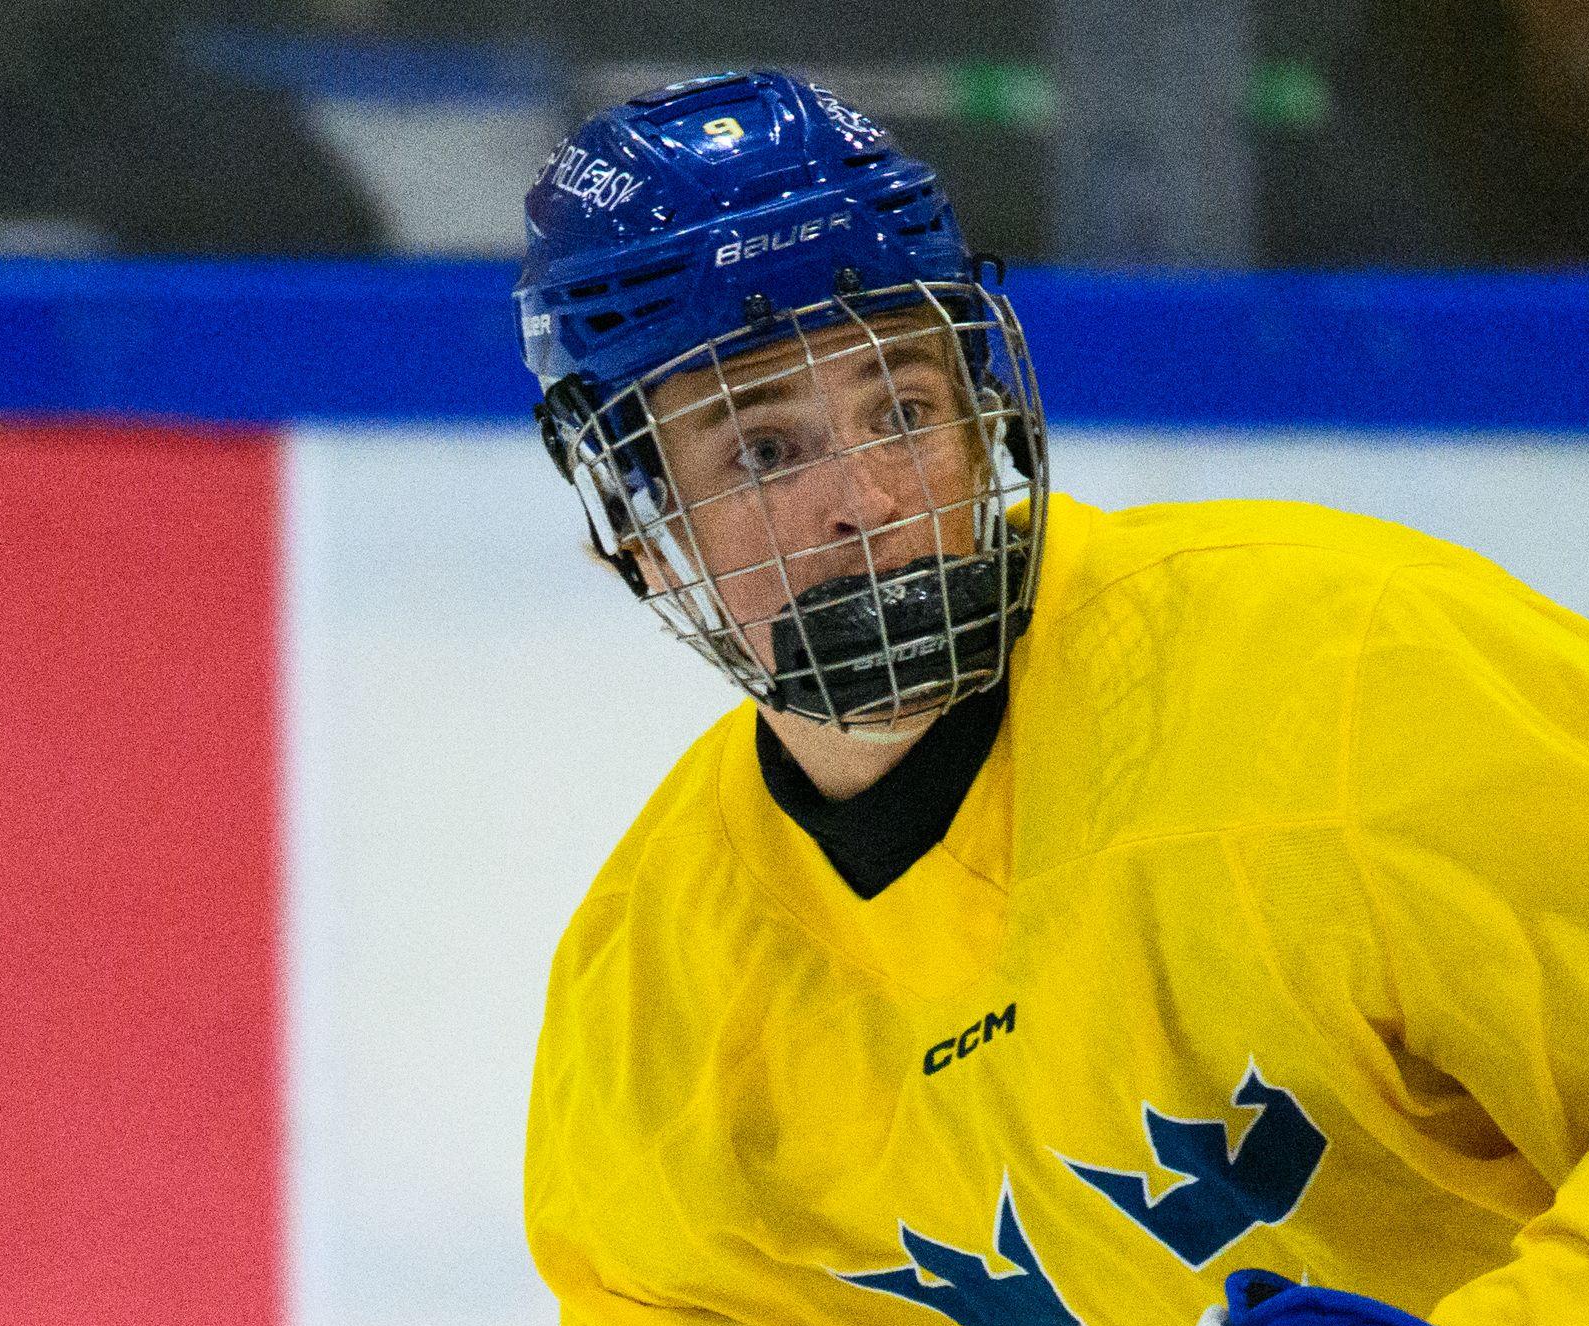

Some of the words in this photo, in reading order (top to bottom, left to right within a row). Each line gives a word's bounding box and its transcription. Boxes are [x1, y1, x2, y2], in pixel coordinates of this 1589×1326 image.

[703, 116, 745, 146] 9
[715, 209, 855, 268] BAUER
[922, 1002, 1017, 1076] CCM
